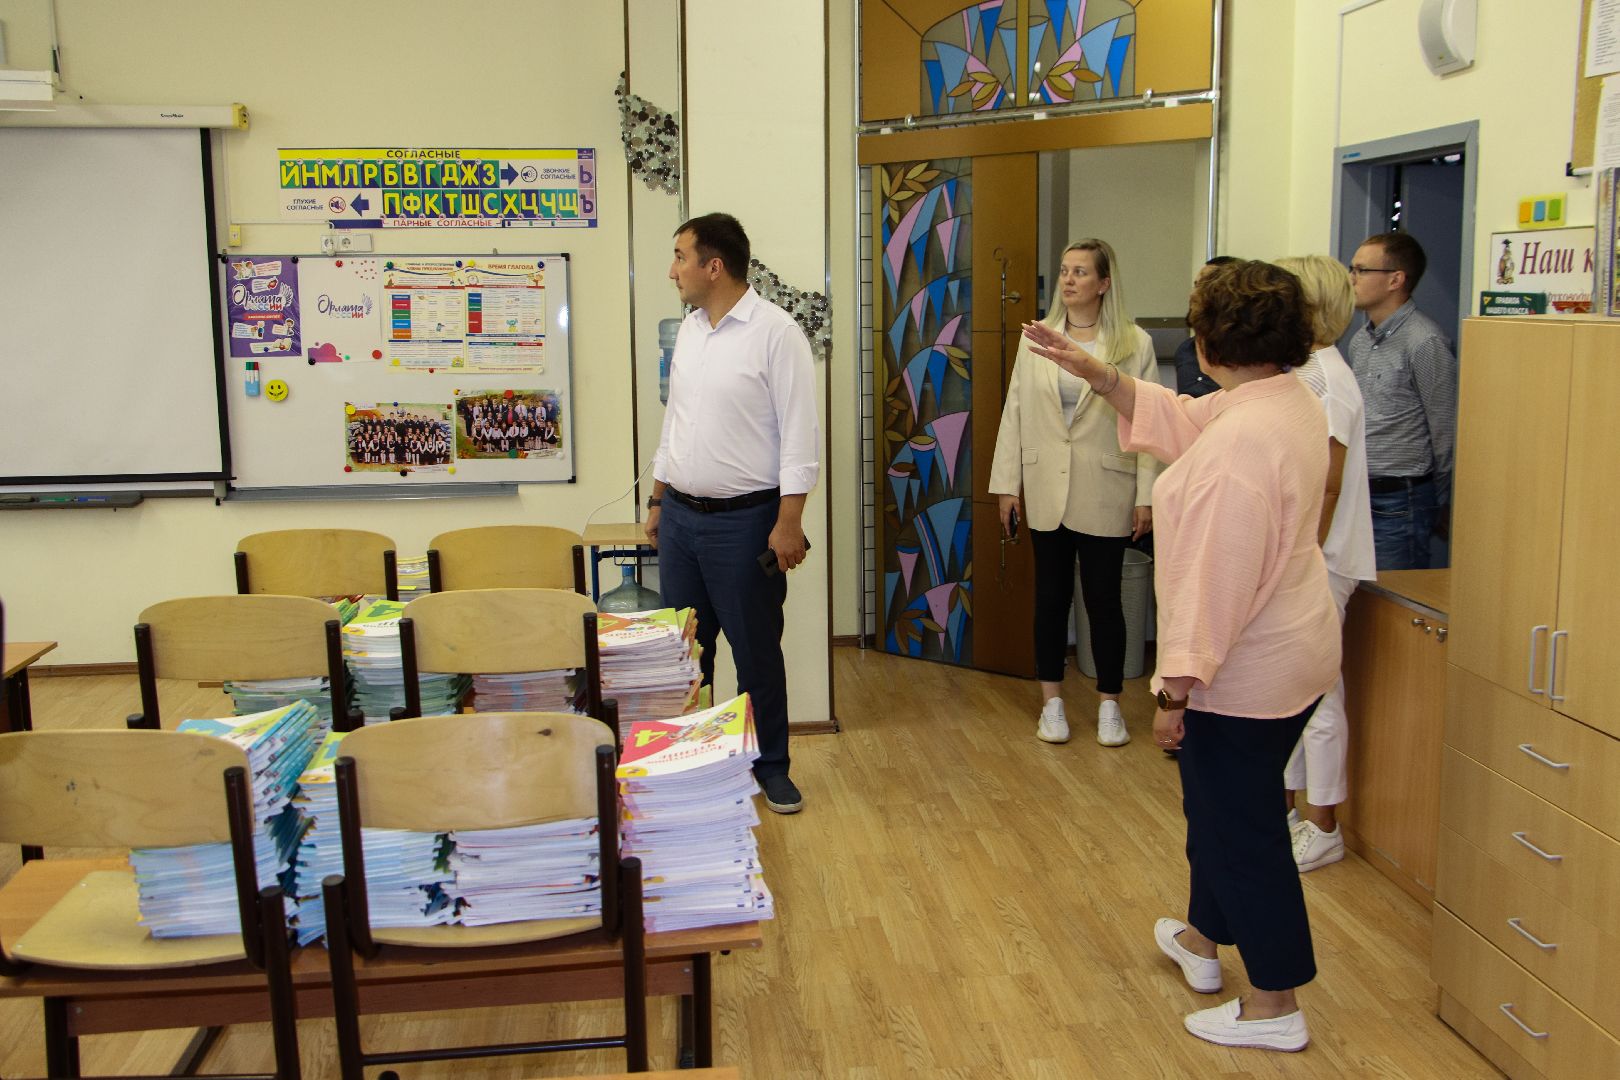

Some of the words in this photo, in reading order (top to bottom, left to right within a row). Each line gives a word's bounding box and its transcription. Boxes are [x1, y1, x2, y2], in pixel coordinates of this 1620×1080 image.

[386, 150, 460, 159] СОГЛАСНЫЕ
[393, 219, 432, 227] ПАРНЫЕ
[437, 219, 493, 227] СОГЛАСНЫЕ
[1519, 241, 1575, 275] Наш
[634, 729, 669, 748] 4
